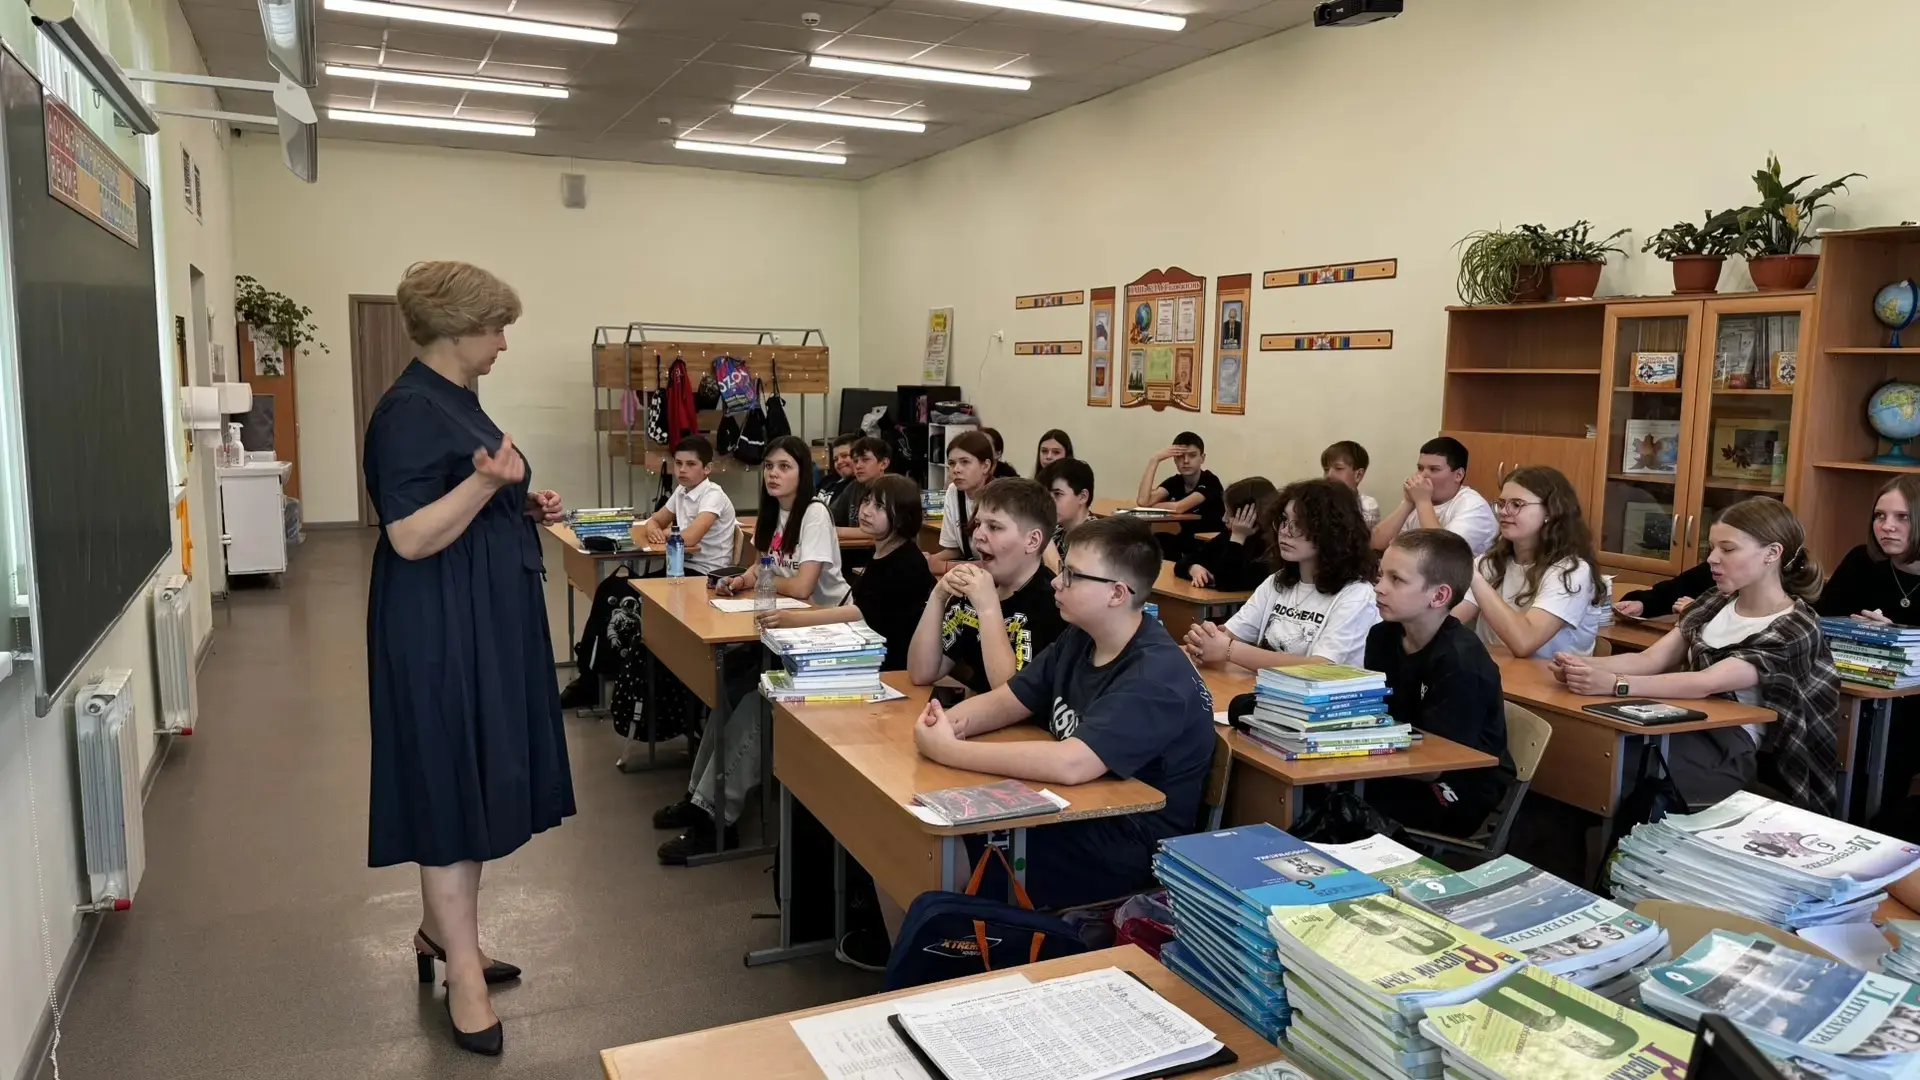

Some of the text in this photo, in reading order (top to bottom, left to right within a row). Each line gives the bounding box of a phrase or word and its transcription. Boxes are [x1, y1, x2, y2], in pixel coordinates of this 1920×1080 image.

[1800, 834, 1882, 870] Математика
[1817, 841, 1836, 852] 6
[1295, 879, 1316, 890] 6
[1425, 880, 1447, 895] 6
[1371, 944, 1499, 990] Русский язык
[1665, 971, 1695, 987] 6
[1438, 1016, 1451, 1029] 2
